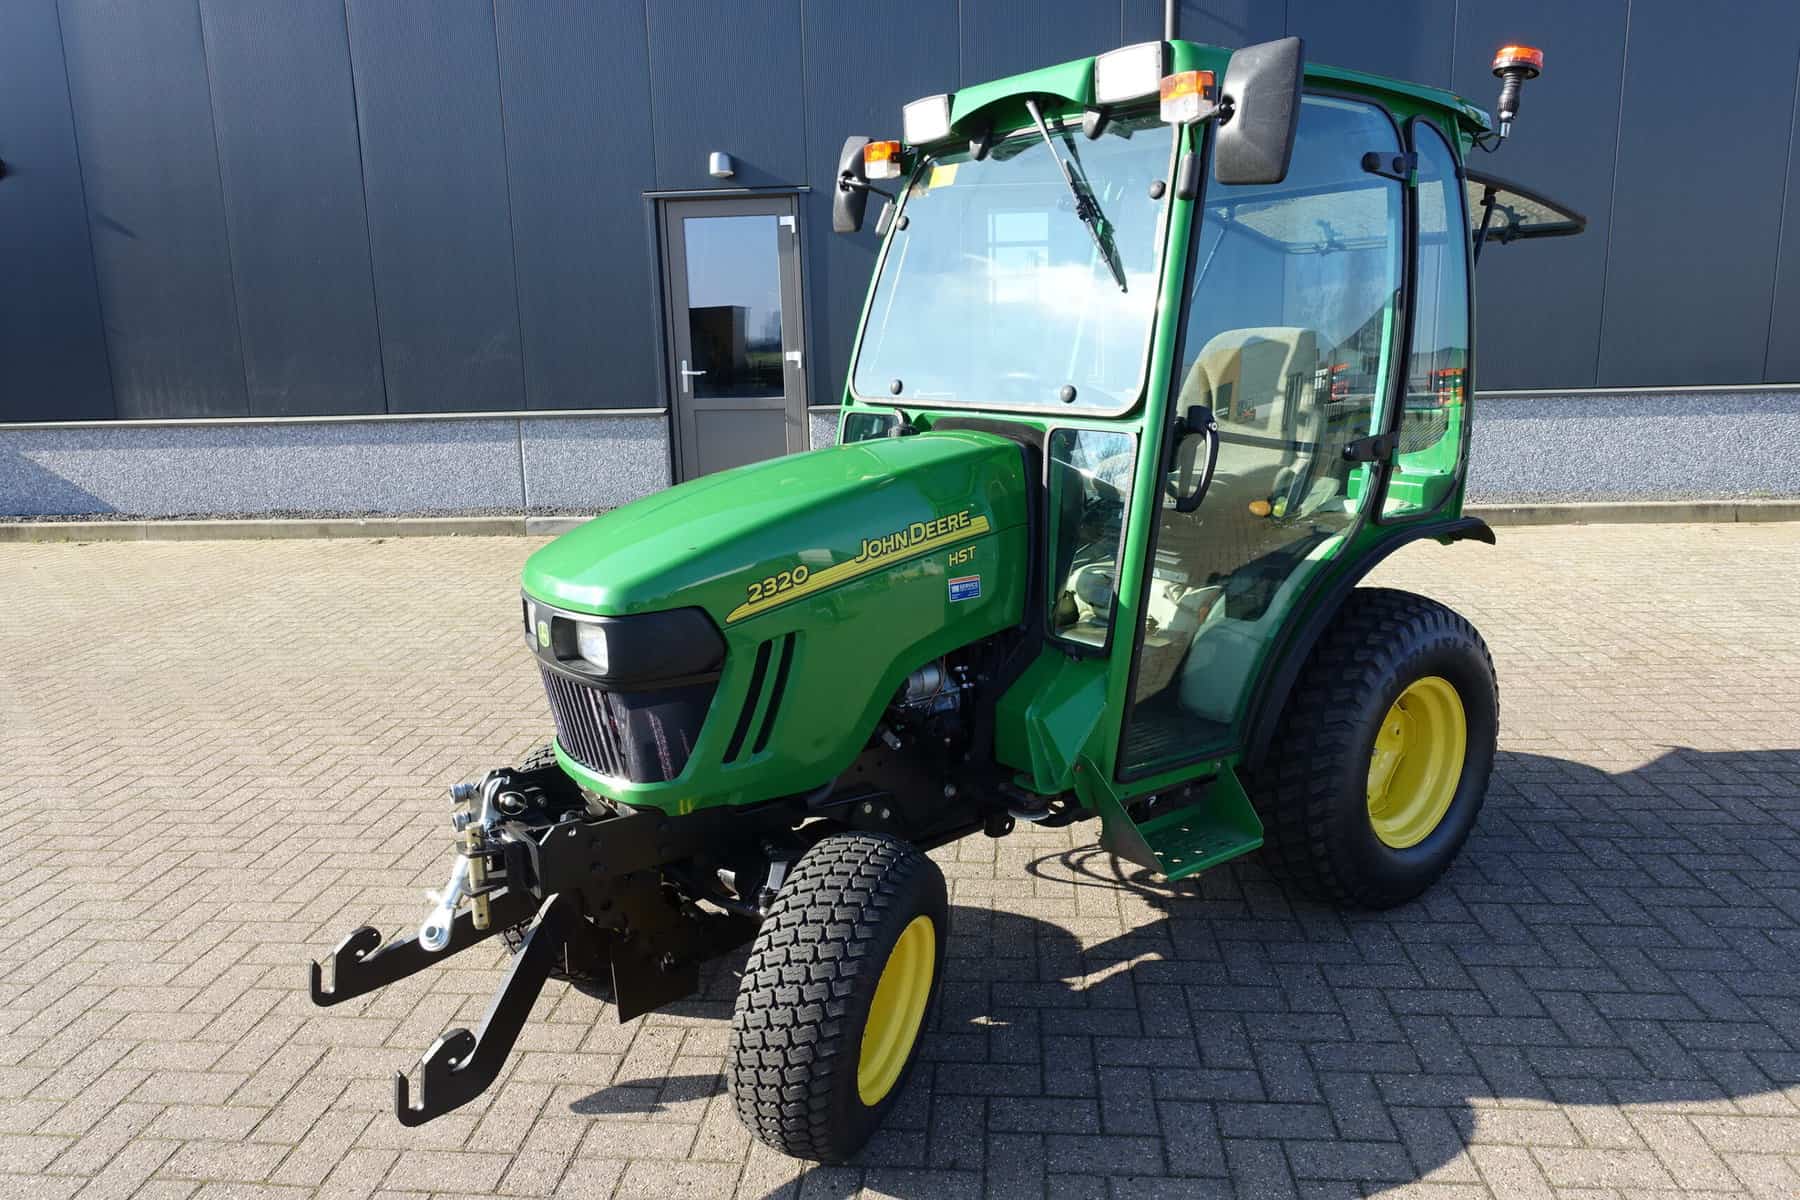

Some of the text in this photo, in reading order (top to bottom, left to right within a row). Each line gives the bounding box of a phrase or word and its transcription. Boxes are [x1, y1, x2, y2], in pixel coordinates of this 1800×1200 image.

[855, 510, 971, 563] JOHN DEERE
[948, 545, 977, 567] HST
[747, 565, 809, 603] 2320
